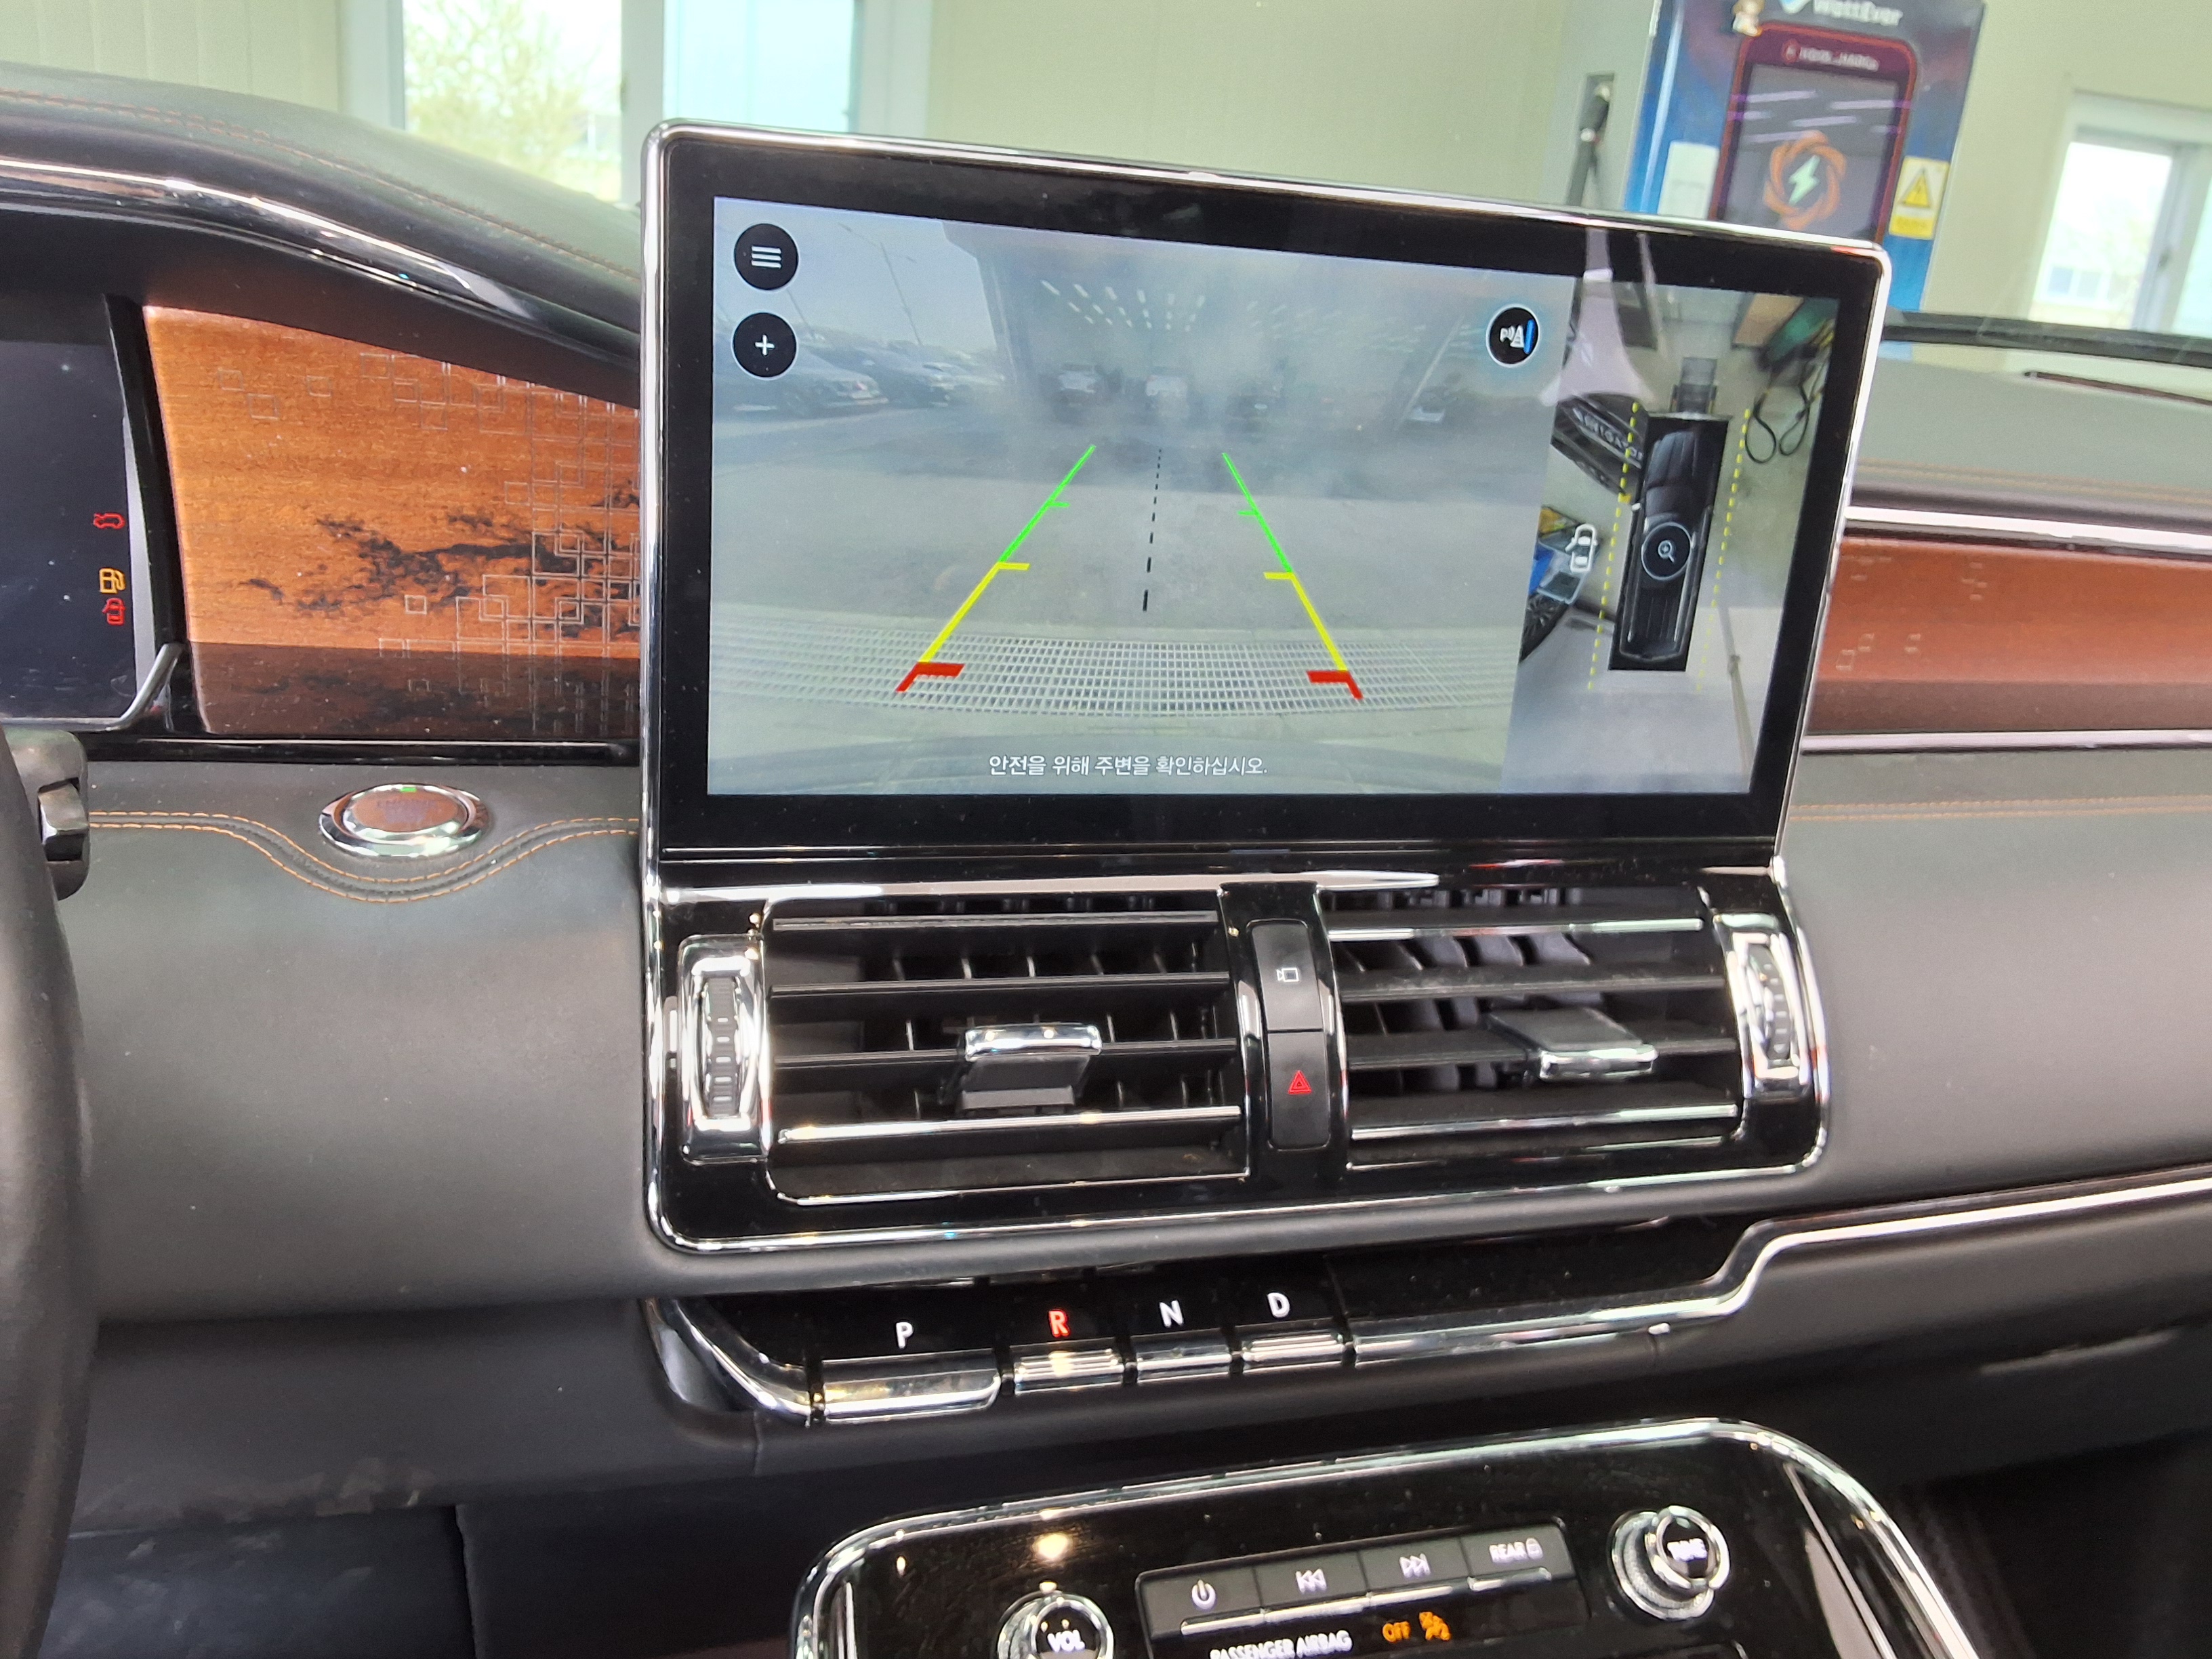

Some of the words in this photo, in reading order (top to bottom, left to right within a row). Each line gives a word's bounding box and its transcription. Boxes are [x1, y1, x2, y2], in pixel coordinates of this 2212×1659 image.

[988, 754, 1046, 776] 안전을
[1051, 755, 1090, 776] 위해
[1094, 755, 1151, 776] 주변을
[1155, 756, 1268, 776] 확인하십시오.
[1159, 1300, 1184, 1327] N
[1267, 1292, 1290, 1317] D
[895, 1321, 914, 1349] P
[1048, 1309, 1069, 1338] R
[1489, 1541, 1527, 1563] REAR
[1047, 1629, 1085, 1652] VOL
[1296, 1629, 1353, 1658] AIRBAG
[1382, 1620, 1410, 1643] OFF
